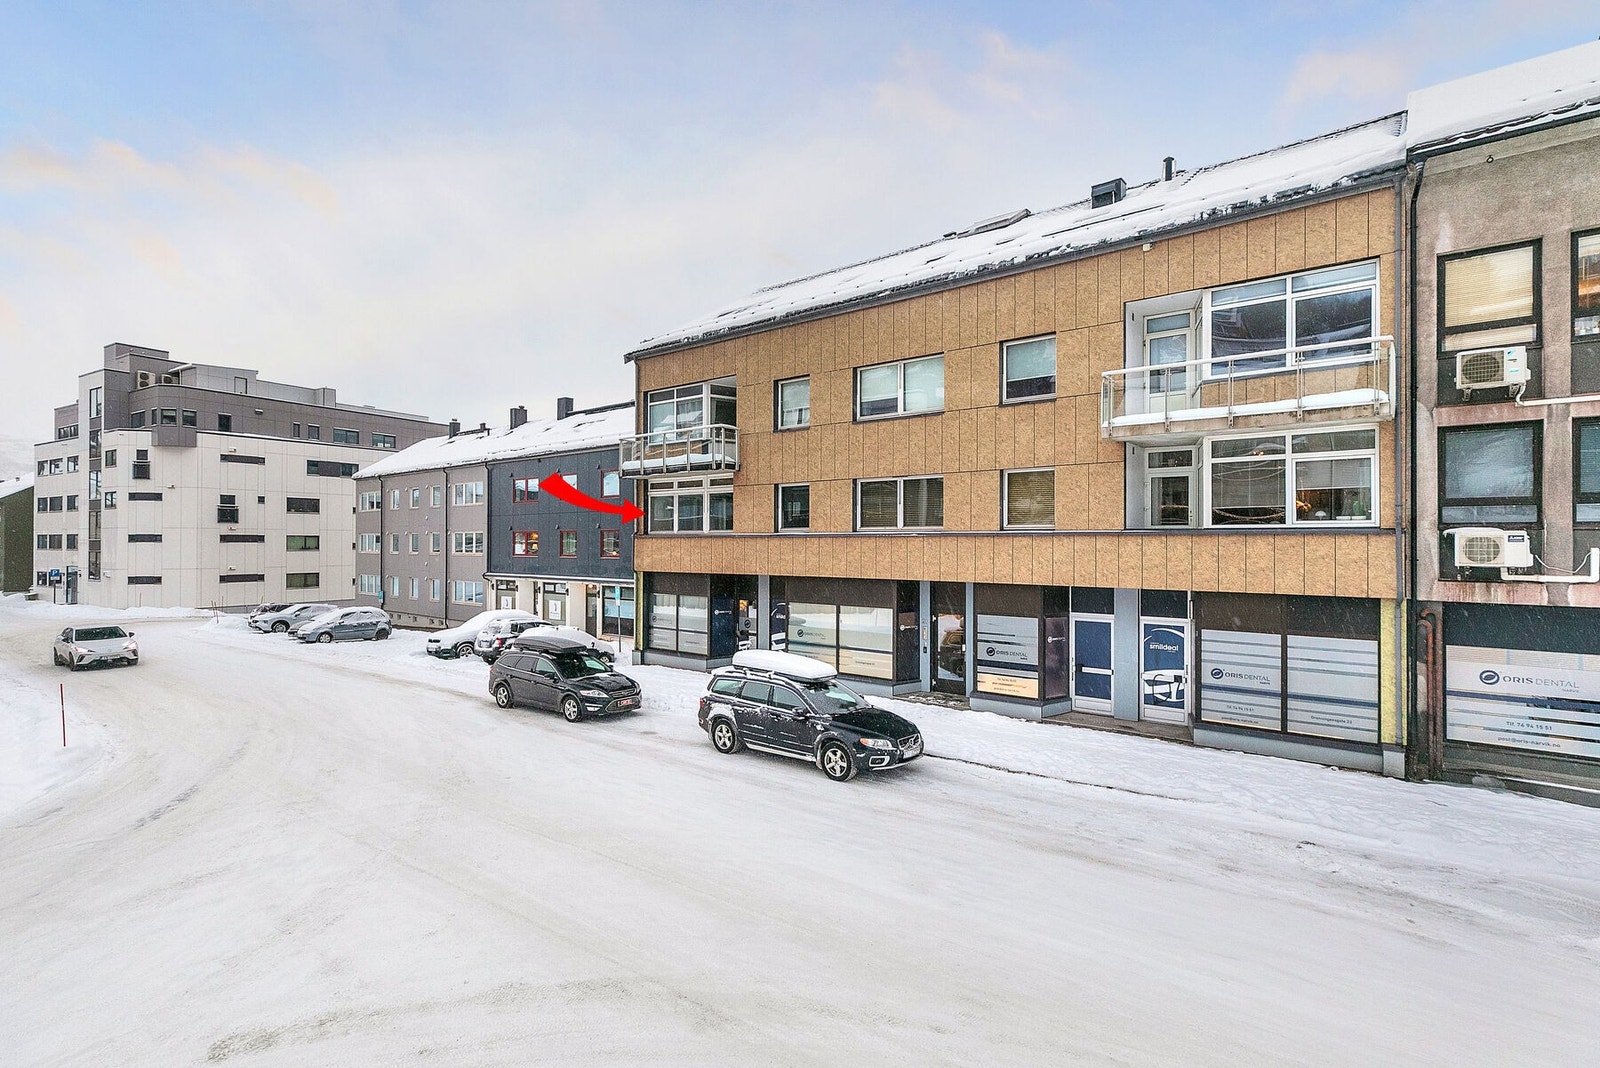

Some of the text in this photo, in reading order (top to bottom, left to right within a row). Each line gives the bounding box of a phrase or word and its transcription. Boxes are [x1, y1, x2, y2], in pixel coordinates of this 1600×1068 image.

[1225, 671, 1244, 679] ORIS
[1503, 675, 1580, 688] ORIS DENTAL
